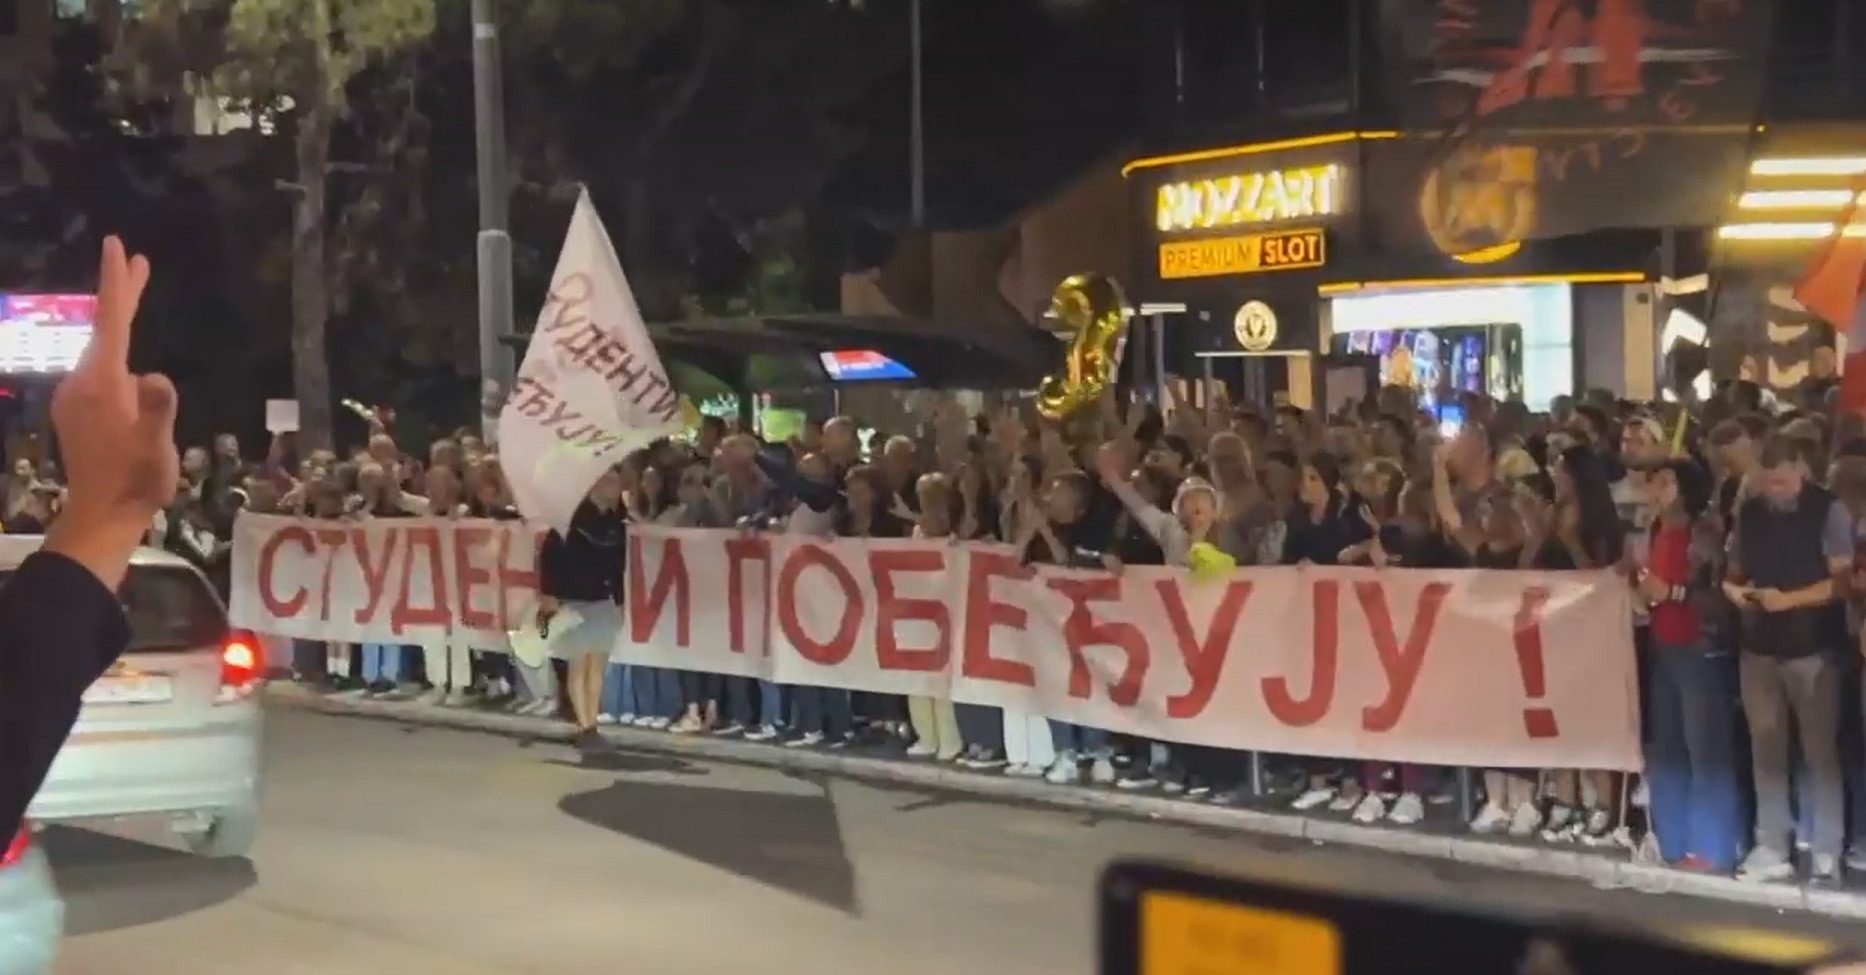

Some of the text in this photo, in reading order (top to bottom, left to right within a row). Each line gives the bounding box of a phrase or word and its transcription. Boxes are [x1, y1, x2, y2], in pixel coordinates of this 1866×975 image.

[1157, 164, 1339, 231] MOZZART
[1165, 236, 1318, 270] PREMIUM SLOT
[258, 526, 690, 646] СТУДЕНИ
